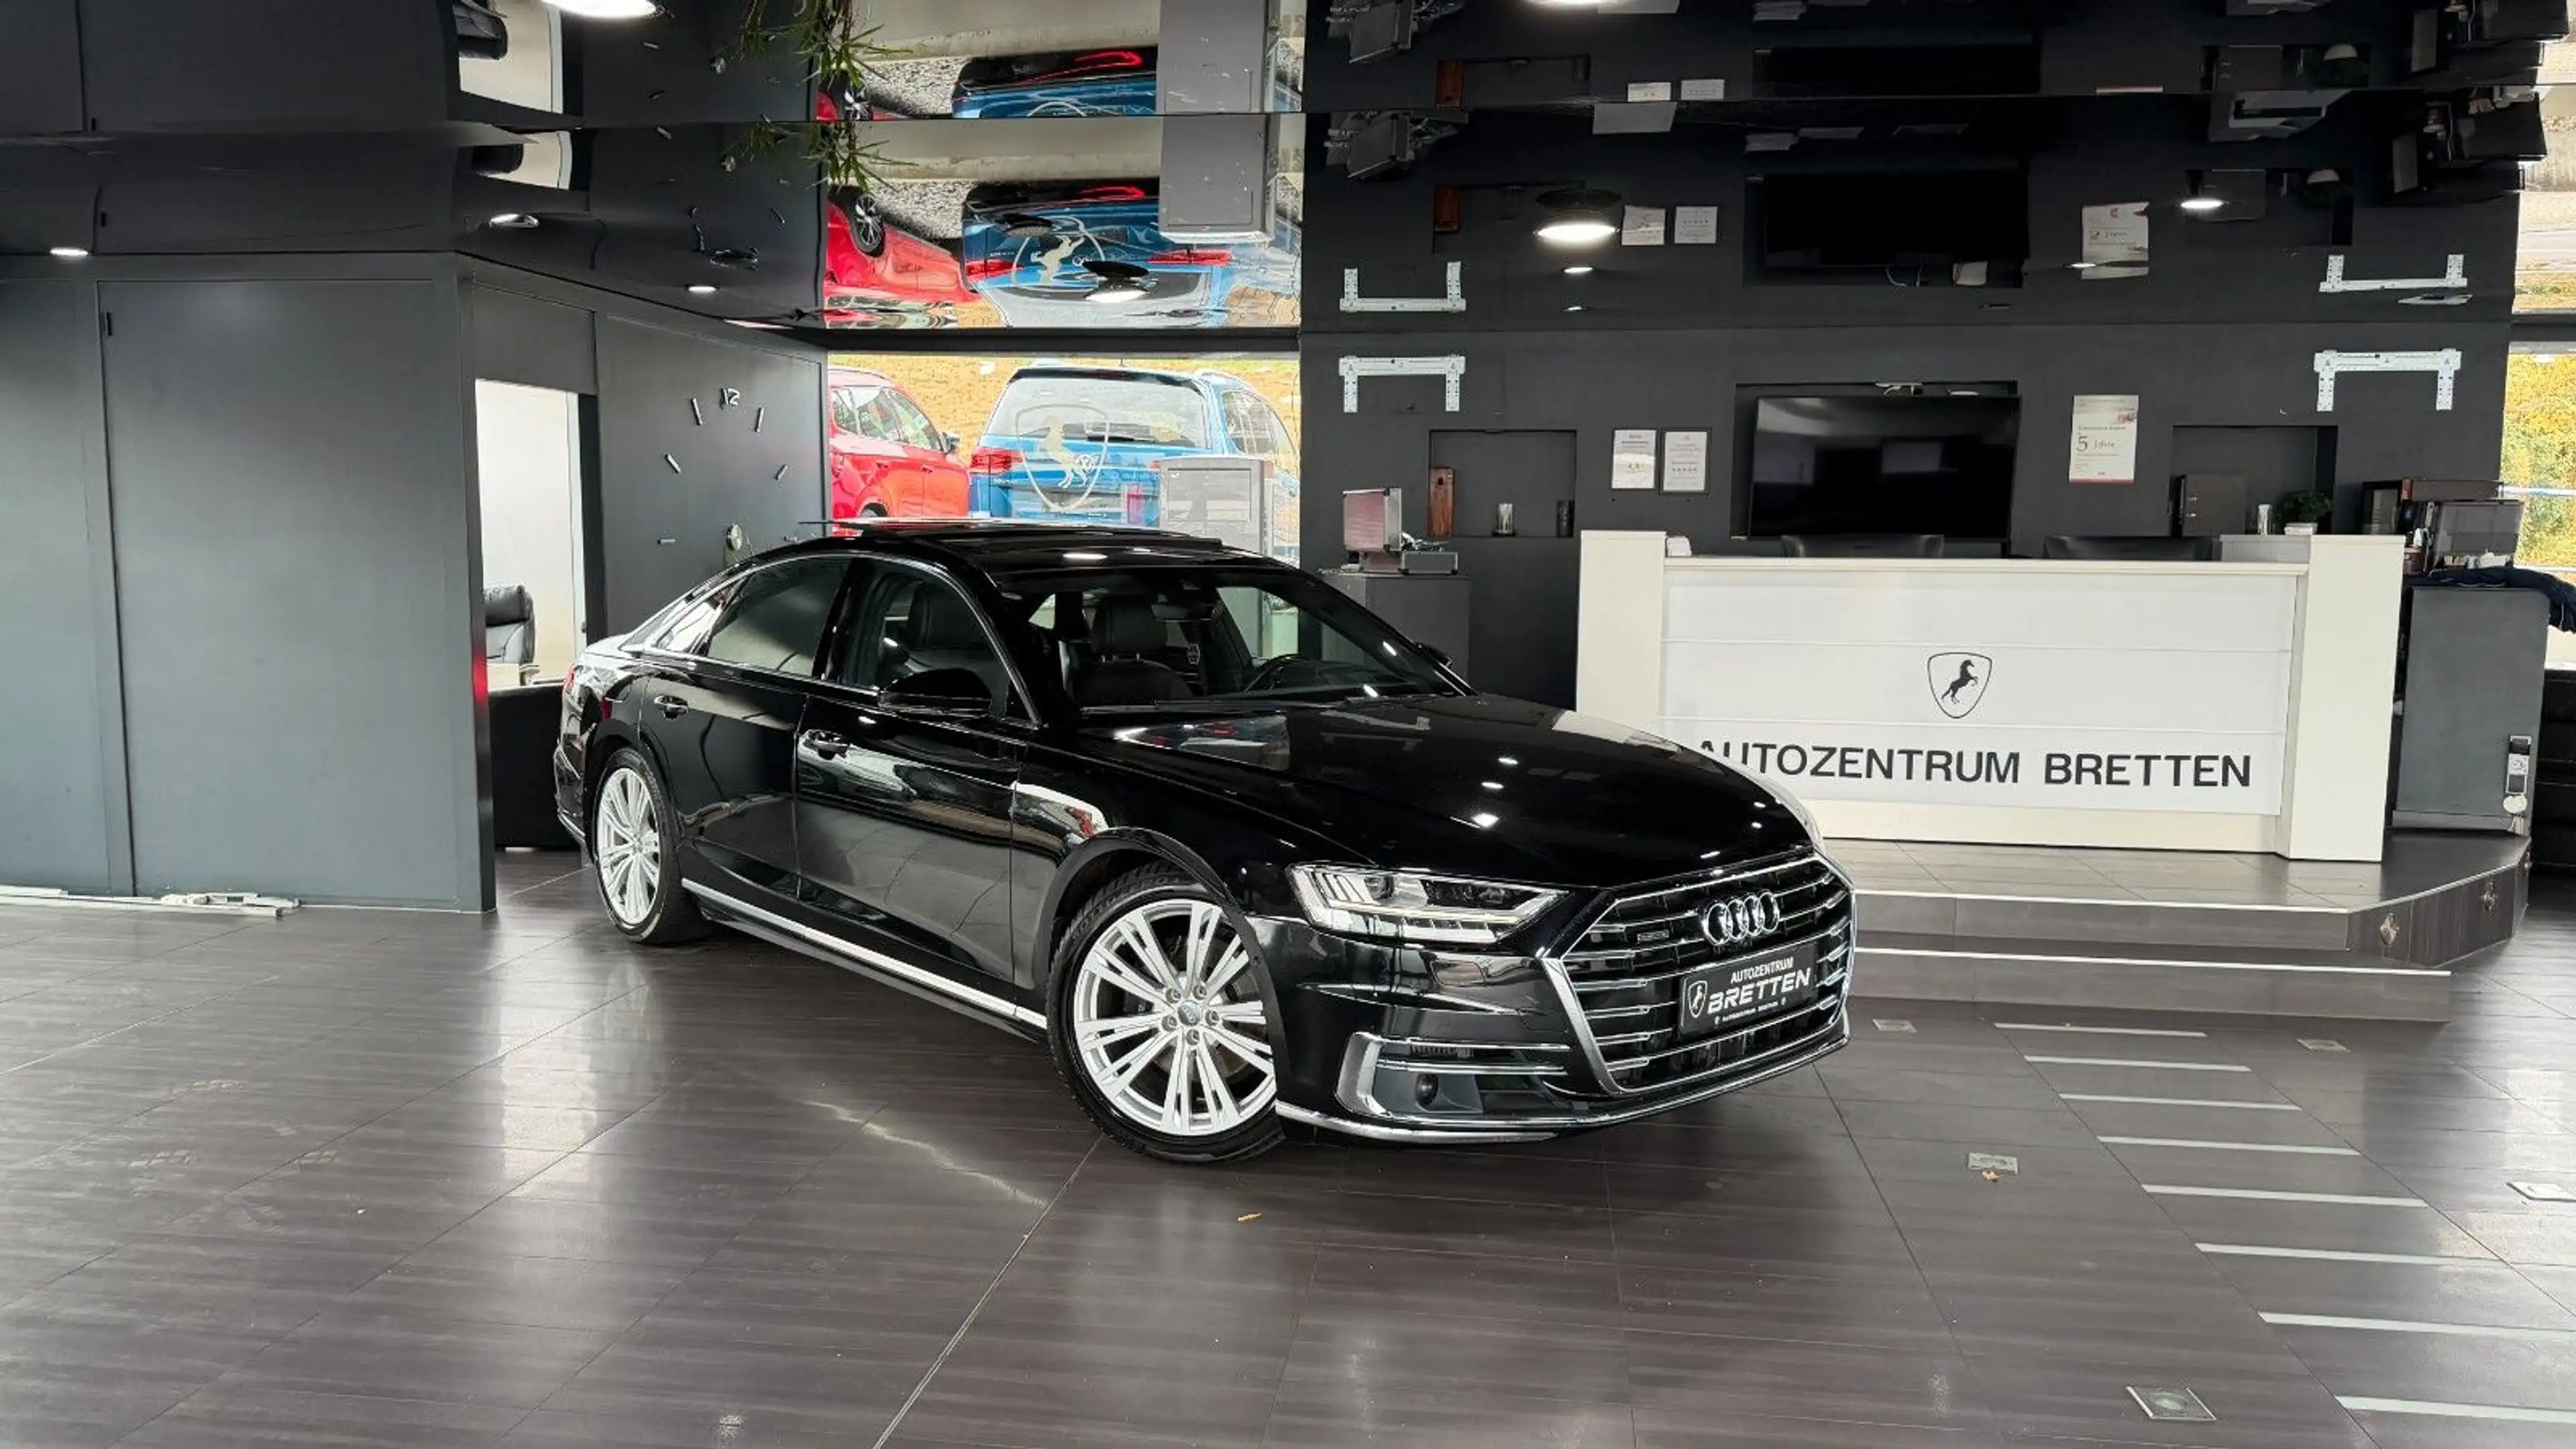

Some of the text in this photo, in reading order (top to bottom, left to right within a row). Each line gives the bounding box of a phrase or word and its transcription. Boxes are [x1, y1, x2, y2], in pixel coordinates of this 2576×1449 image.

[722, 388, 740, 405] 12
[2077, 435, 2088, 451] 5
[2044, 752, 2251, 787] BRETTEN
[1730, 956, 1794, 984] AUTOZENTRUM
[1707, 967, 1811, 1015] BRETTEN
